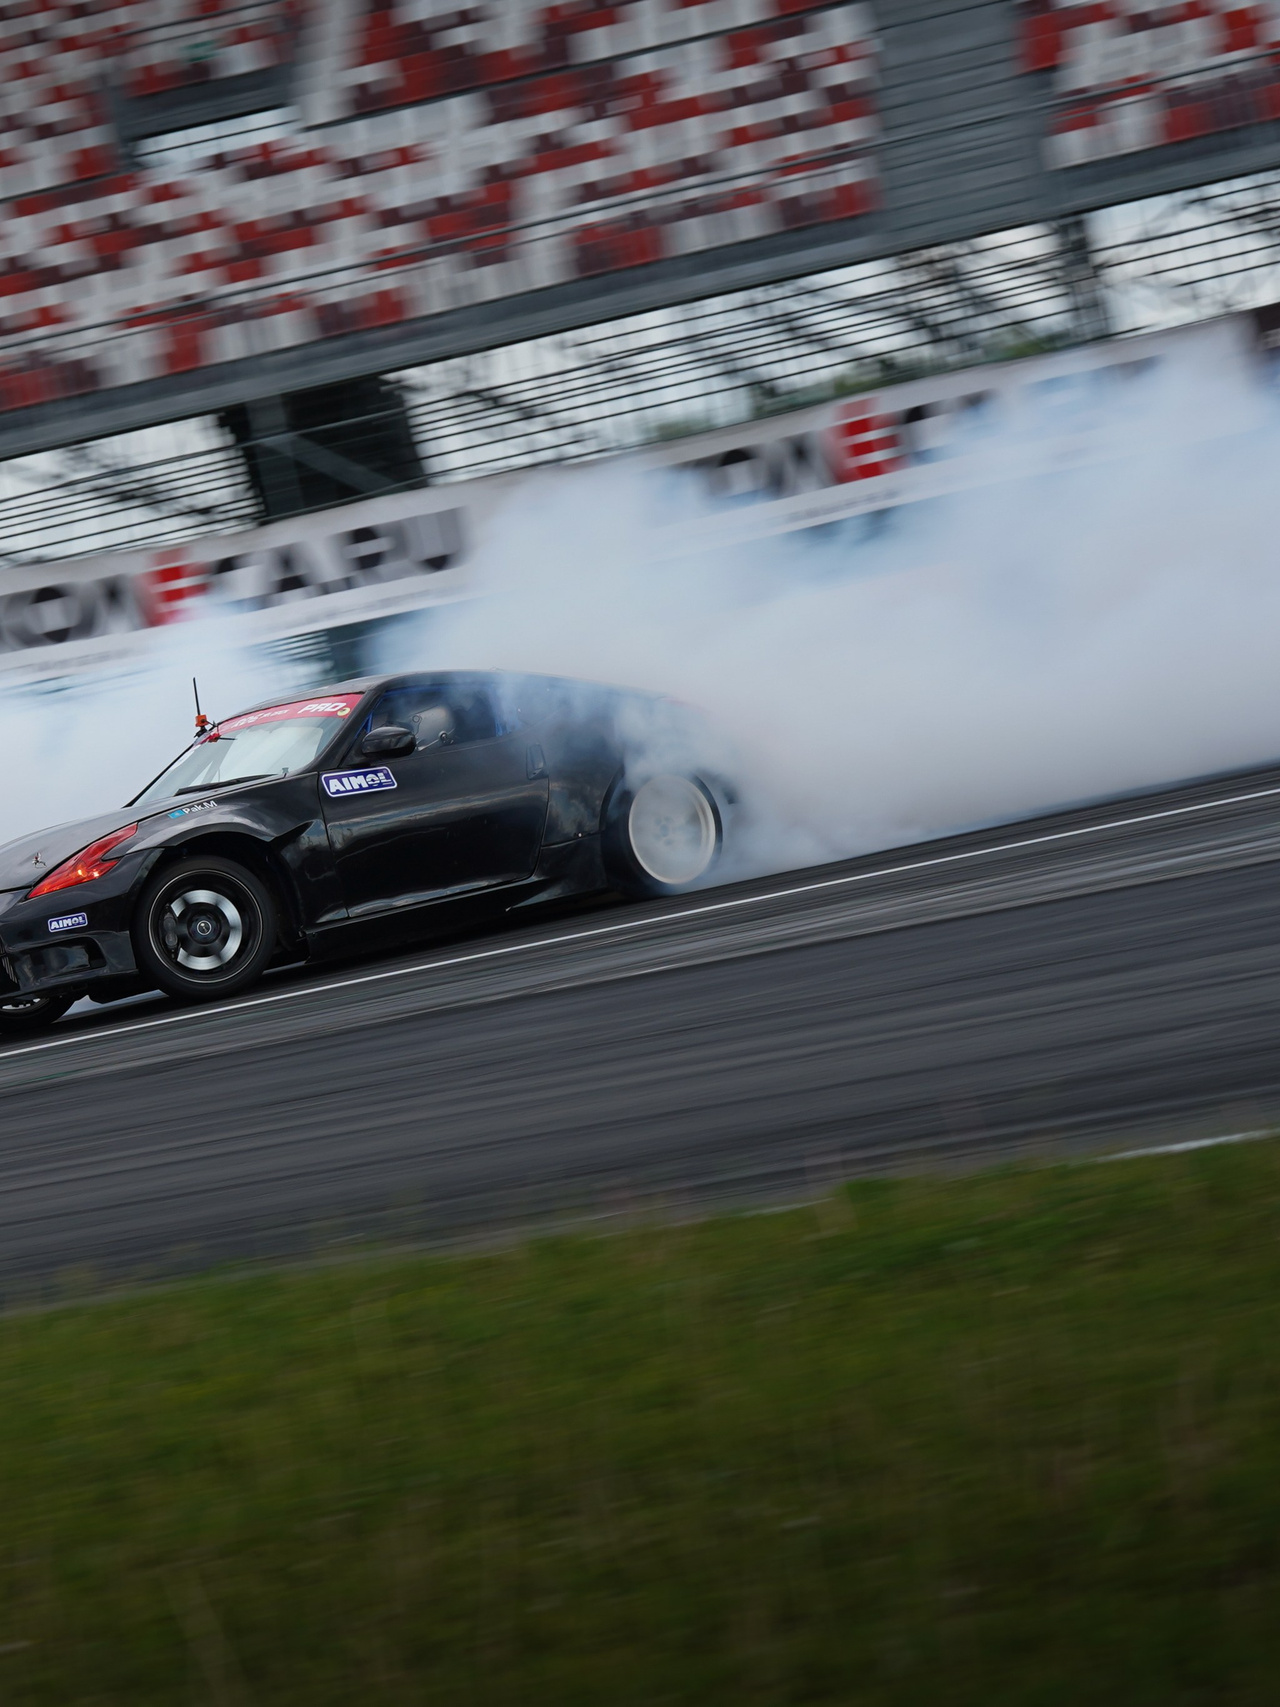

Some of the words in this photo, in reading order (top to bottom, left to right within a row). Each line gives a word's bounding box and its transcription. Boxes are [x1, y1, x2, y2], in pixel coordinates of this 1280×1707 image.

[298, 702, 346, 714] PRO
[328, 772, 392, 793] AIMOL
[182, 800, 218, 814] Pak.M
[51, 916, 85, 930] AIMOL
